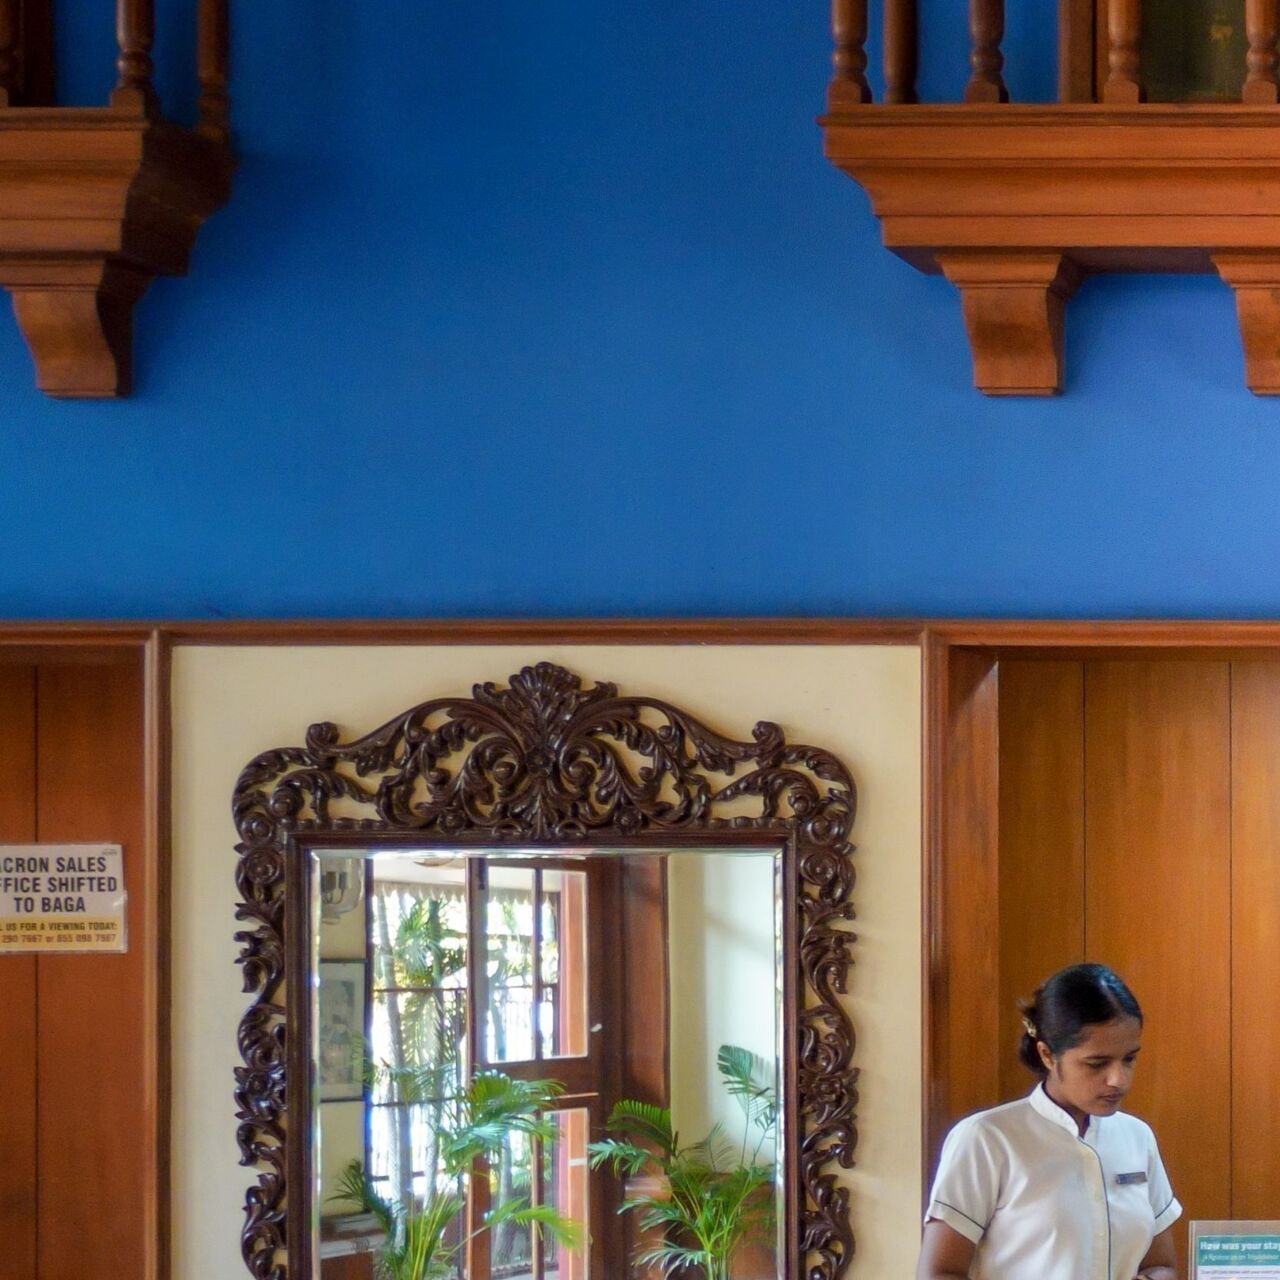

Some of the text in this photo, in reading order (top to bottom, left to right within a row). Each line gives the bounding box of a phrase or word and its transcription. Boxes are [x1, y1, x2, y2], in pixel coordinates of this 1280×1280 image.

[0, 856, 106, 873] CRON SALES
[0, 876, 117, 893] FICE SHIFTED
[13, 896, 86, 913] TO BAGA
[20, 923, 37, 931] FOR
[48, 922, 85, 931] VIEWING
[1200, 1241, 1220, 1250] How
[1241, 1243, 1262, 1251] your
